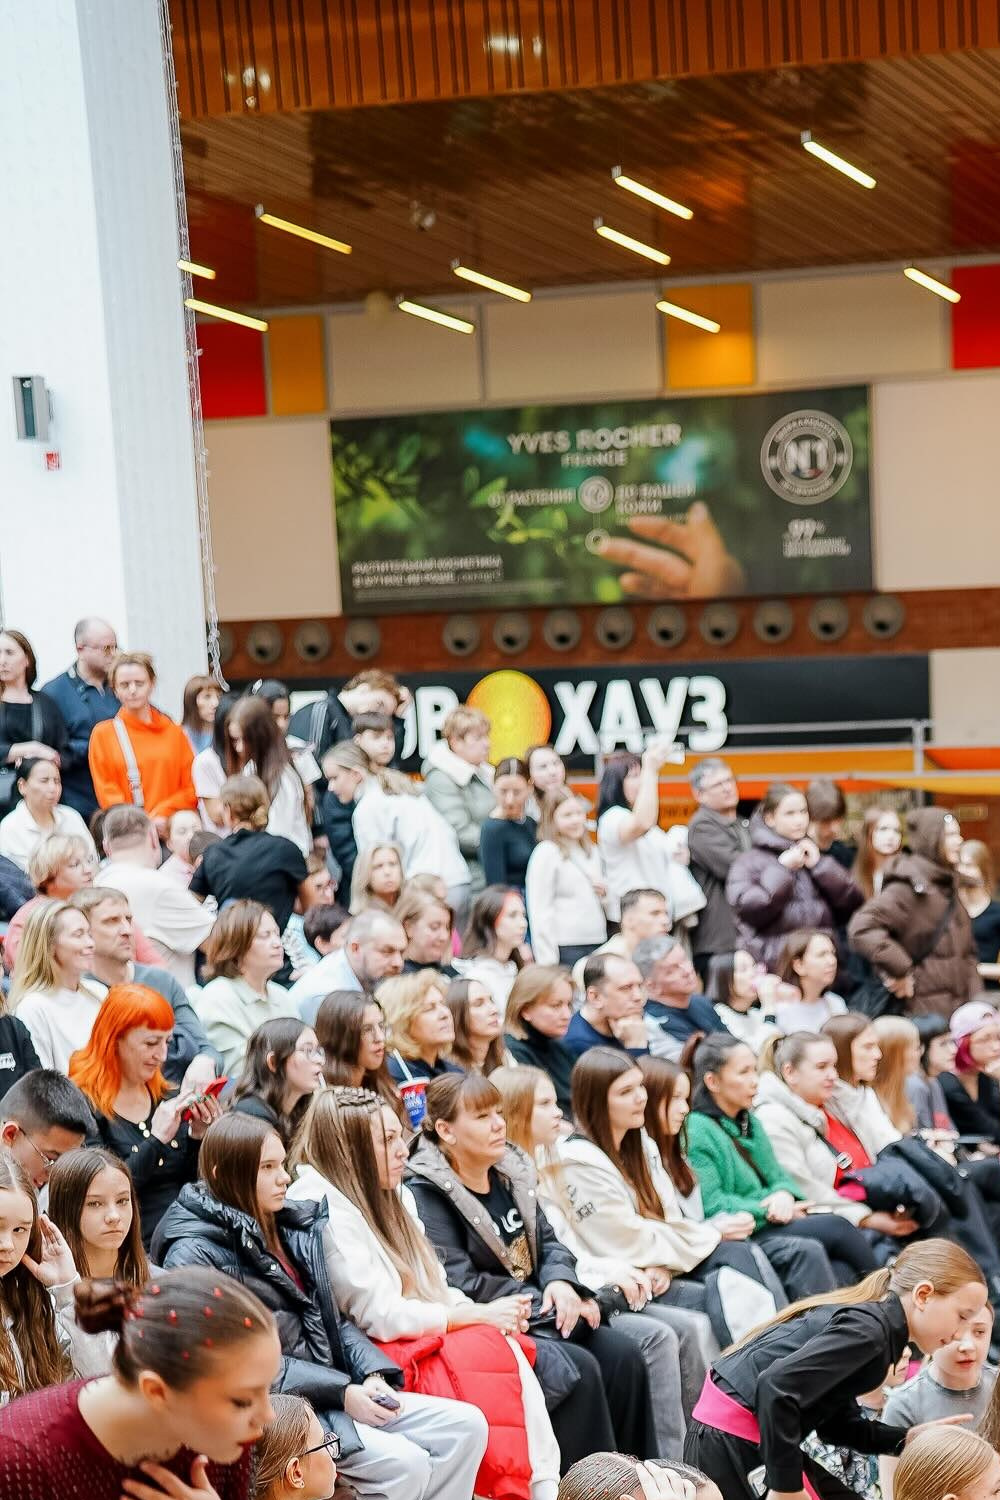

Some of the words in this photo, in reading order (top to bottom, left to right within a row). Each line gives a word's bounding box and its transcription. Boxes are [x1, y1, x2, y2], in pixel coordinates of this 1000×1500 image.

[507, 430, 571, 455] YVES
[575, 423, 682, 450] ROCHER
[553, 675, 728, 755] ХАУЗ
